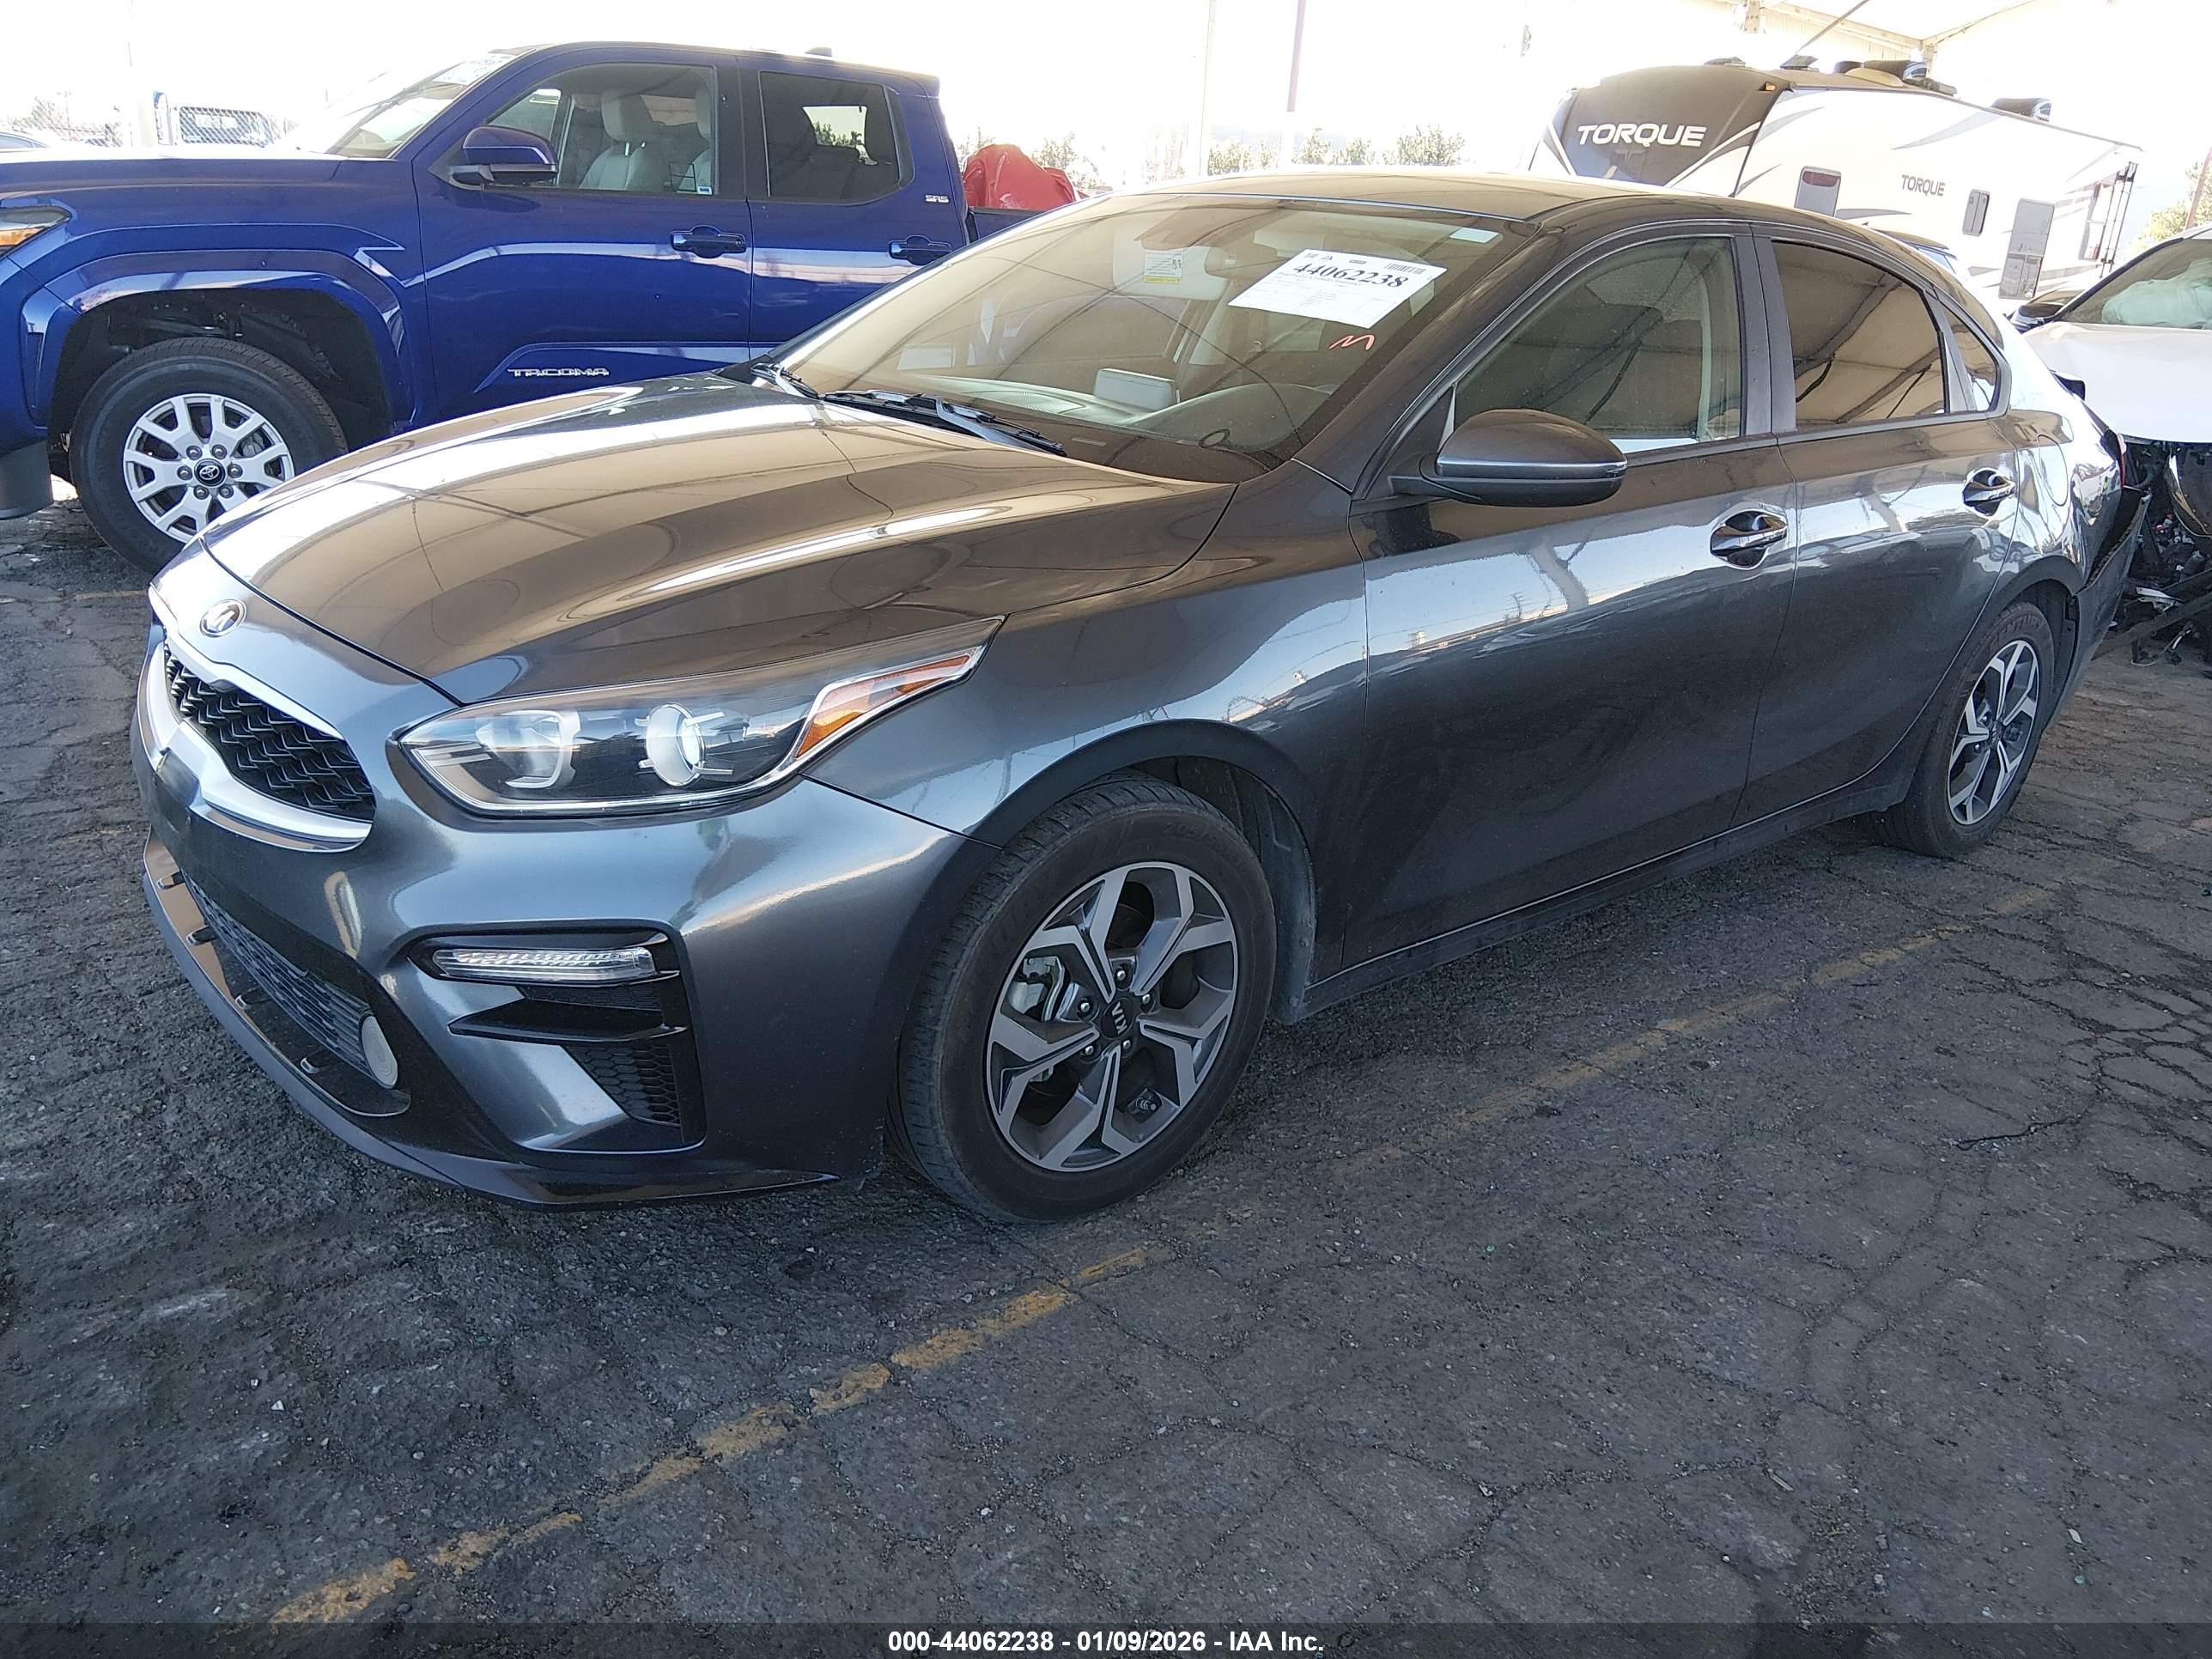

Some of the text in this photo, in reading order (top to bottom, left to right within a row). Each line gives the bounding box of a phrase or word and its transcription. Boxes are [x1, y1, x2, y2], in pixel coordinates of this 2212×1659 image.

[1577, 123, 1707, 149] TORQUE
[1901, 173, 1946, 197] TORQUE
[1293, 263, 1409, 289] 44062238
[507, 368, 610, 378] TACOMA
[1111, 1000, 1128, 1036] KIA
